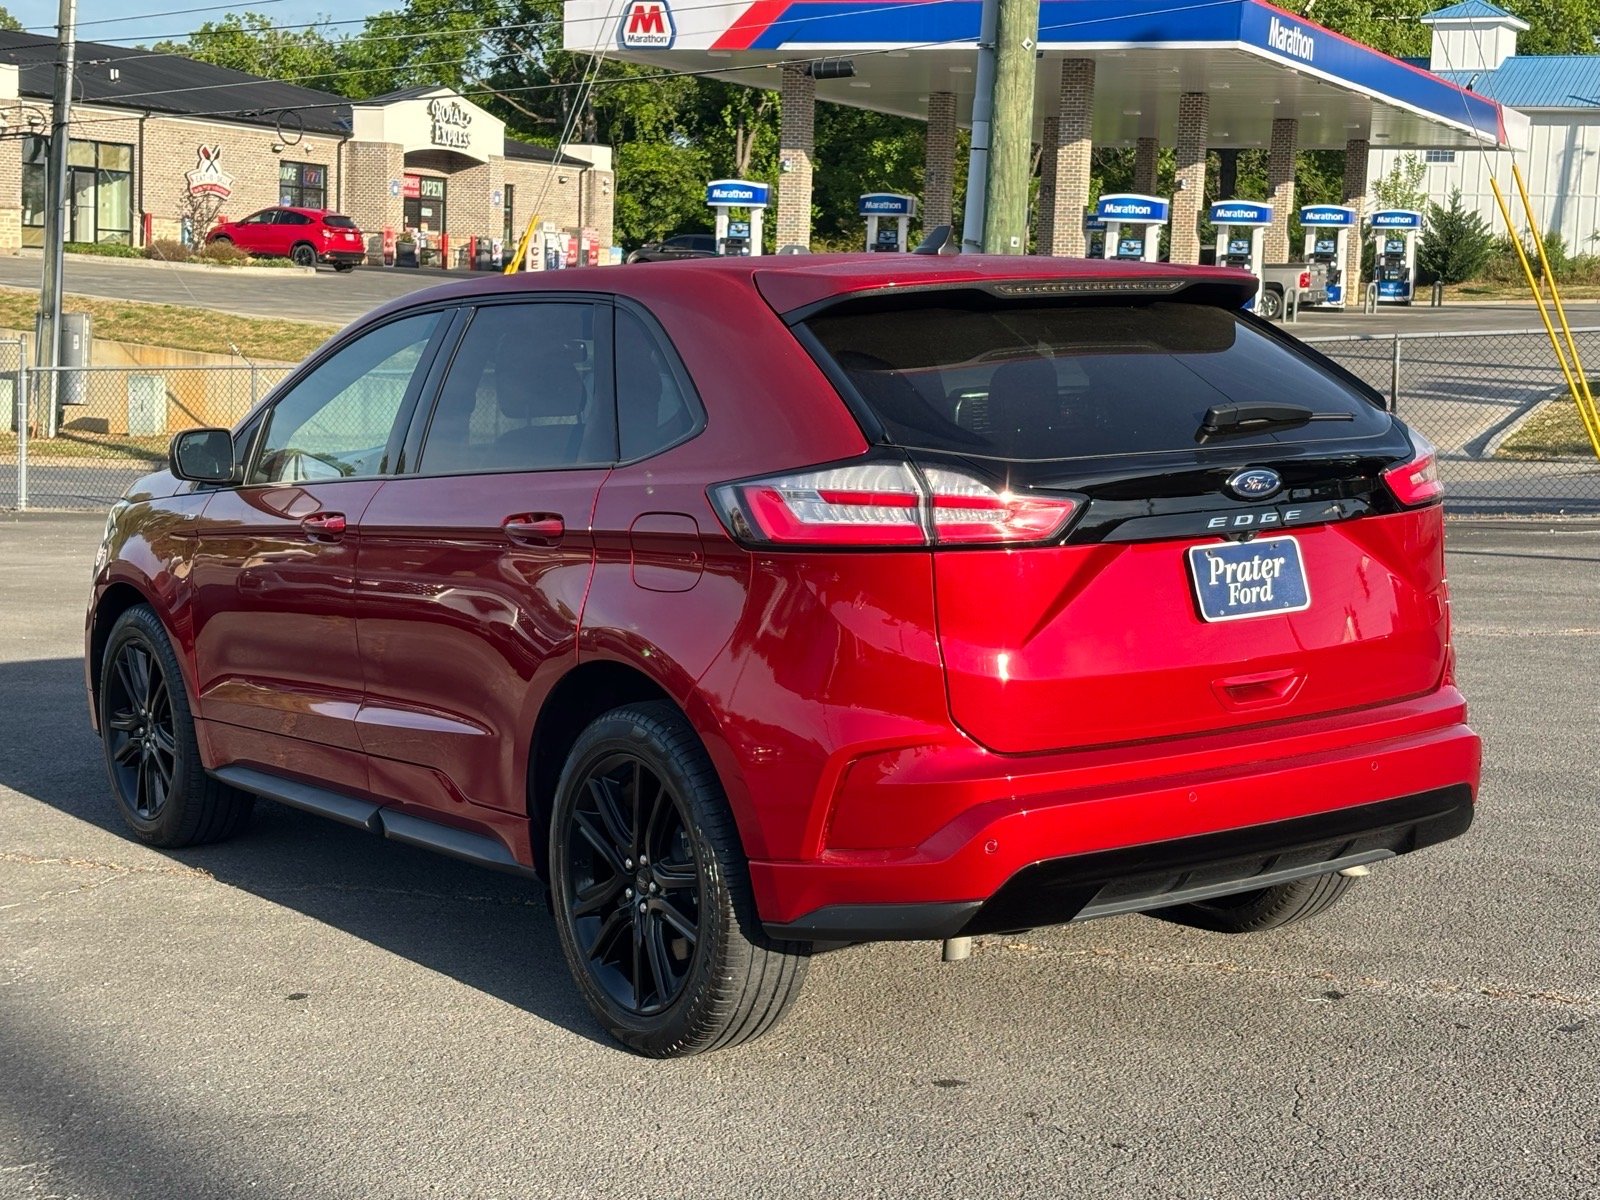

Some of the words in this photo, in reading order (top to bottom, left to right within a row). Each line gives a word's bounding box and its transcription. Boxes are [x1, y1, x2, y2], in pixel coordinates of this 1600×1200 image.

[627, 34, 667, 43] Marathon
[1267, 16, 1314, 61] Marathon
[427, 98, 472, 129] ROYAL
[431, 122, 471, 149] EXPRESS
[421, 180, 443, 197] OPEN
[712, 189, 753, 198] Marathon
[864, 201, 902, 209] Marathon
[1104, 203, 1151, 215] Marathon
[1216, 209, 1258, 218] Marathon
[1305, 212, 1344, 221] Marathon
[1376, 216, 1412, 224] Marathon
[530, 233, 540, 270] ICE
[1244, 475, 1272, 491] Ford
[1207, 509, 1302, 529] EDGE
[1207, 555, 1285, 586] Prater
[1228, 577, 1274, 606] Ford
